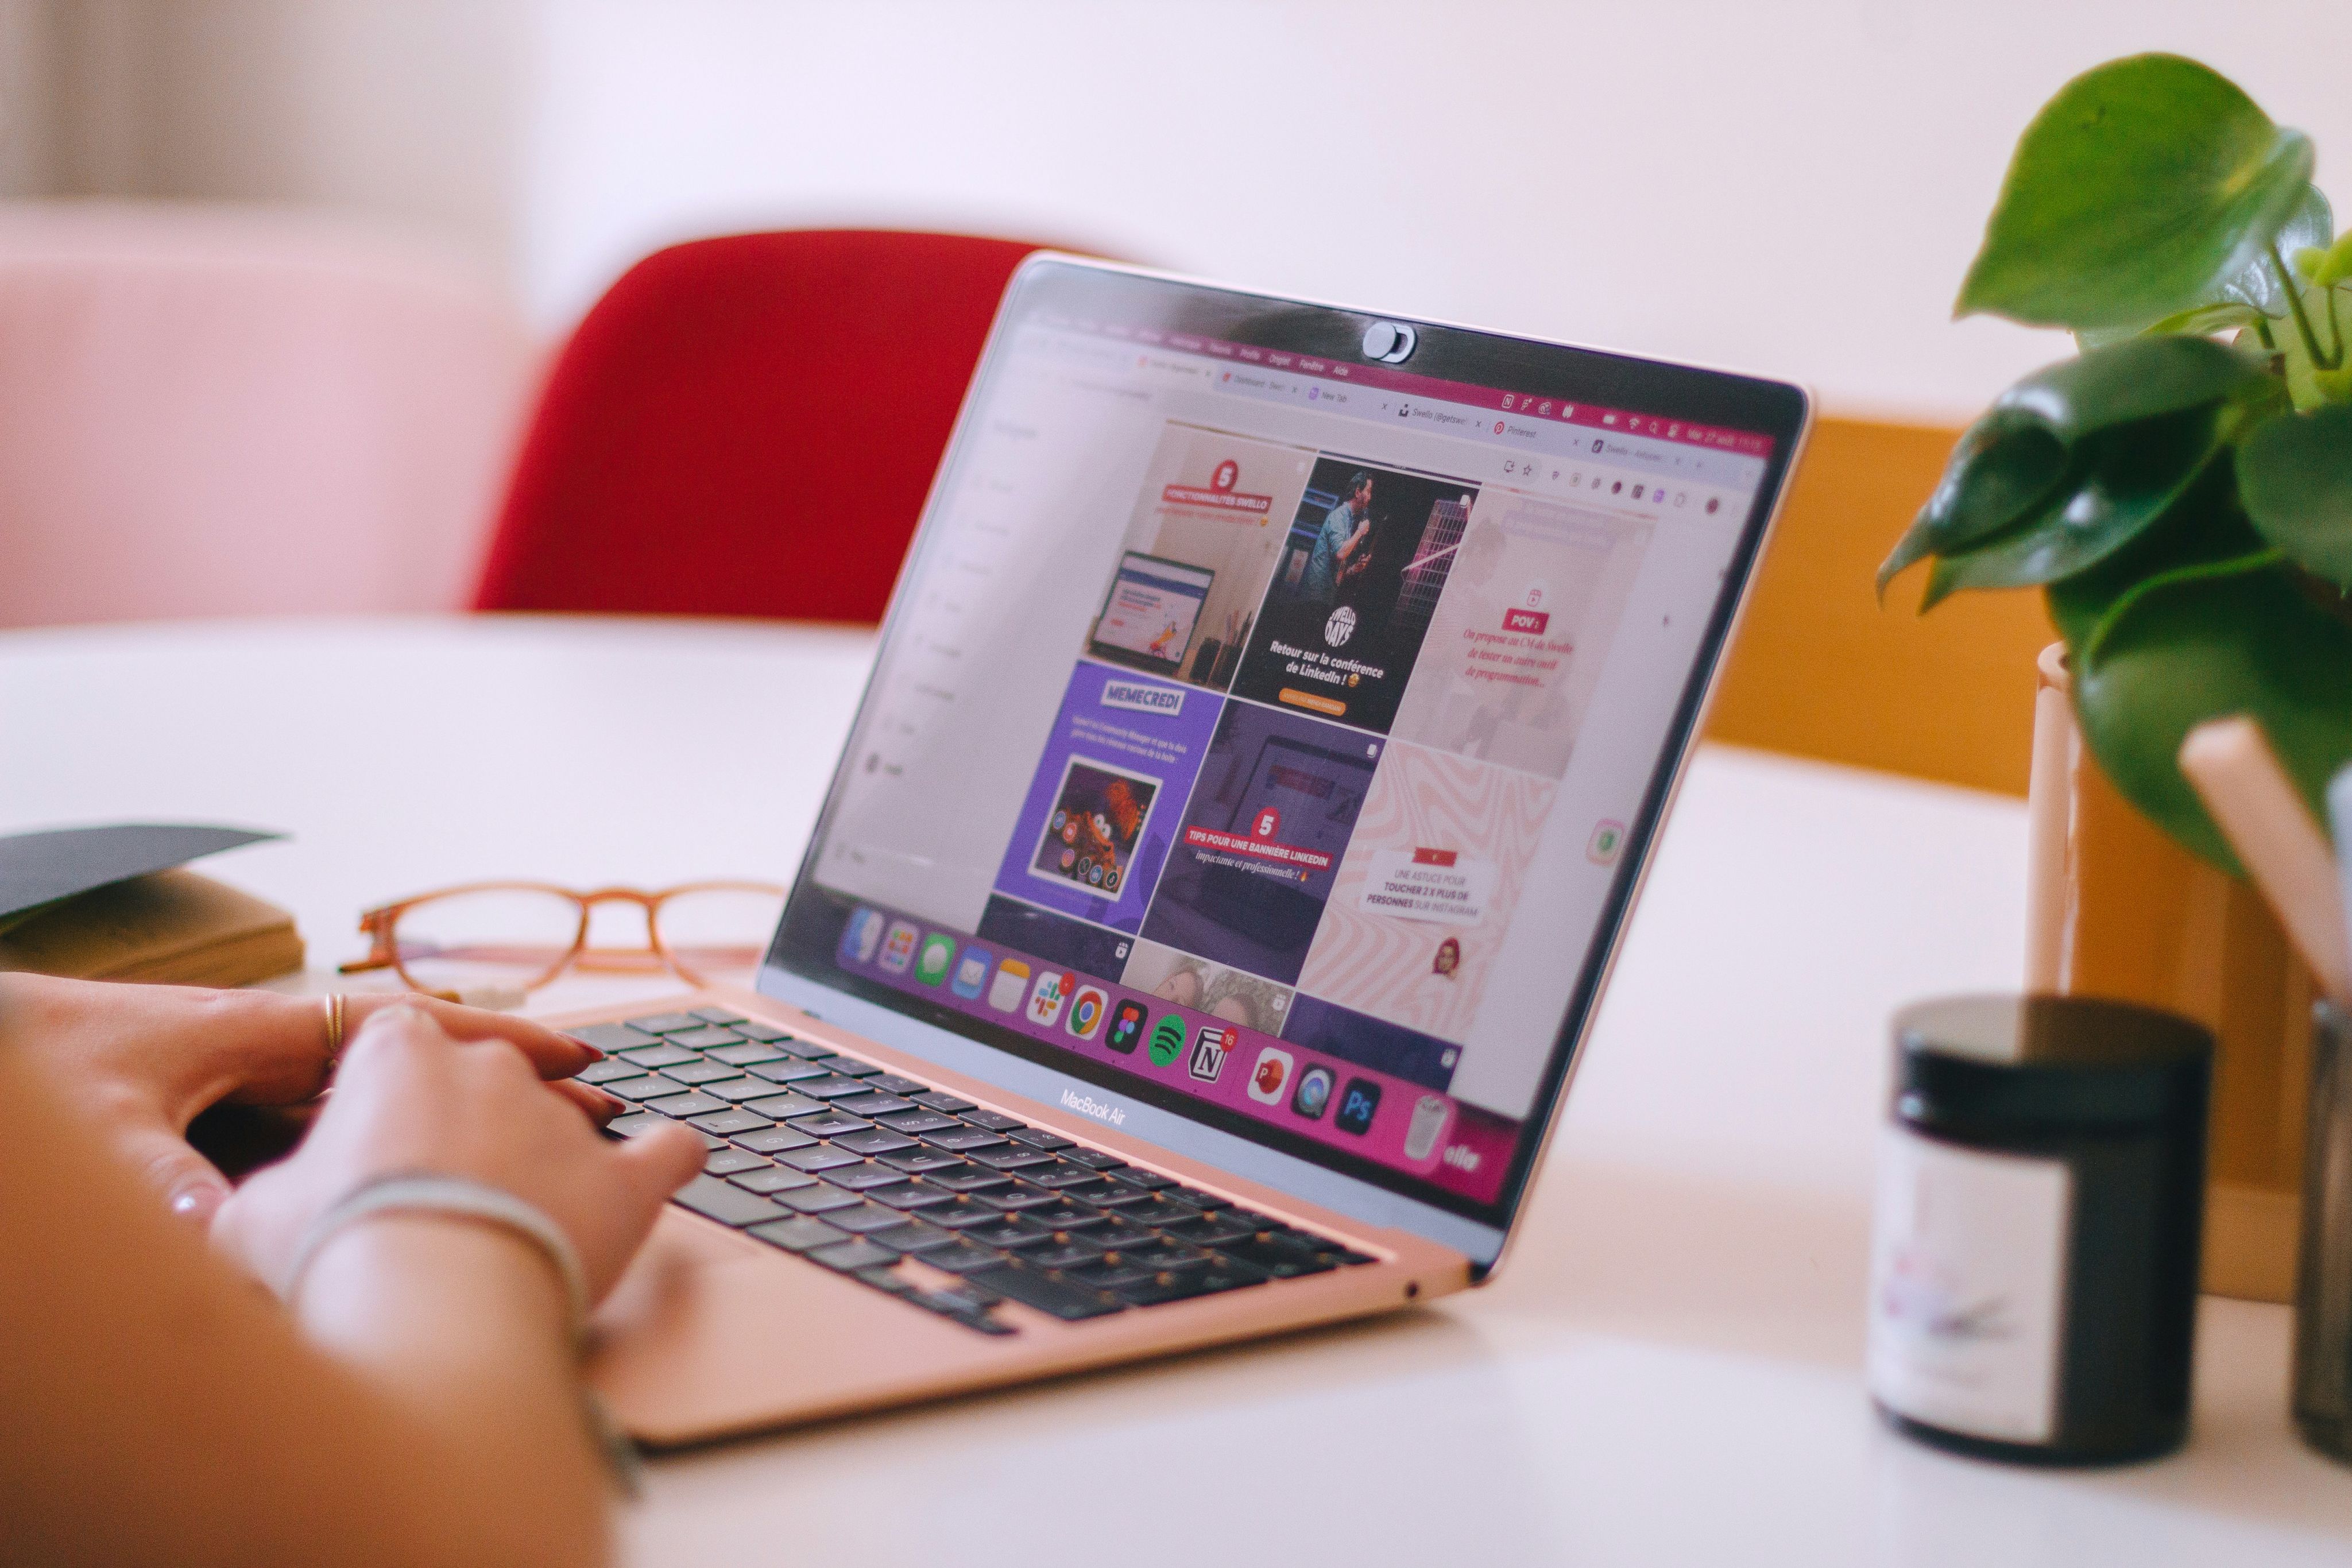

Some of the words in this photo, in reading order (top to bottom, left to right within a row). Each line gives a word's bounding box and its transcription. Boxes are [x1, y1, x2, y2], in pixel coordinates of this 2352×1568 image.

[1332, 366, 1348, 376] Aide
[1412, 408, 1432, 420] Swello
[1507, 426, 1537, 439] Pinterest
[1218, 466, 1233, 487] 5
[1237, 497, 1268, 510] SWELLO
[1329, 606, 1356, 626] SWELLO
[1511, 614, 1534, 628] POV
[1324, 620, 1353, 647] DAYS
[1464, 629, 1475, 639] On
[1475, 632, 1507, 645] propose
[1535, 638, 1545, 650] de
[1270, 640, 1302, 659] Retour
[1302, 650, 1320, 663] sur
[1320, 653, 1330, 665] la
[1330, 659, 1384, 679] conférence
[1468, 647, 1478, 659] de
[1478, 650, 1502, 661] tester
[1502, 653, 1513, 663] un
[1286, 661, 1299, 674] de
[1299, 664, 1341, 685] LinkedIn
[1341, 674, 1347, 686] !
[1465, 665, 1475, 677] de
[1105, 686, 1181, 710] MEMECREDI
[1258, 814, 1274, 836] 5
[1189, 830, 1206, 842] TIPS
[1206, 834, 1230, 847] POUR
[1231, 839, 1248, 850] UNE
[1249, 842, 1290, 859] BANNIÈRE
[1290, 850, 1329, 867] LINKEDIN
[1195, 850, 1235, 867] impactante
[1235, 859, 1243, 868] et
[1241, 860, 1295, 879] professionnelle
[1395, 869, 1411, 879] UNE
[1411, 872, 1442, 884] ASTUCE
[1442, 875, 1466, 887] POUR
[1384, 881, 1422, 895] TOUCHER
[1422, 886, 1429, 896] 2
[1436, 889, 1456, 900] PLUS
[1457, 891, 1469, 902] DE
[1367, 893, 1413, 908] PERSONNES
[1414, 900, 1430, 911] SUR
[1430, 901, 1479, 917] INSTAGRAM
[1224, 1034, 1235, 1046] 16
[1199, 1046, 1221, 1076] N
[1259, 1067, 1269, 1079] P
[1061, 1089, 1109, 1120] MacBook
[1108, 1107, 1125, 1125] Air
[1344, 1090, 1372, 1121] Ps
